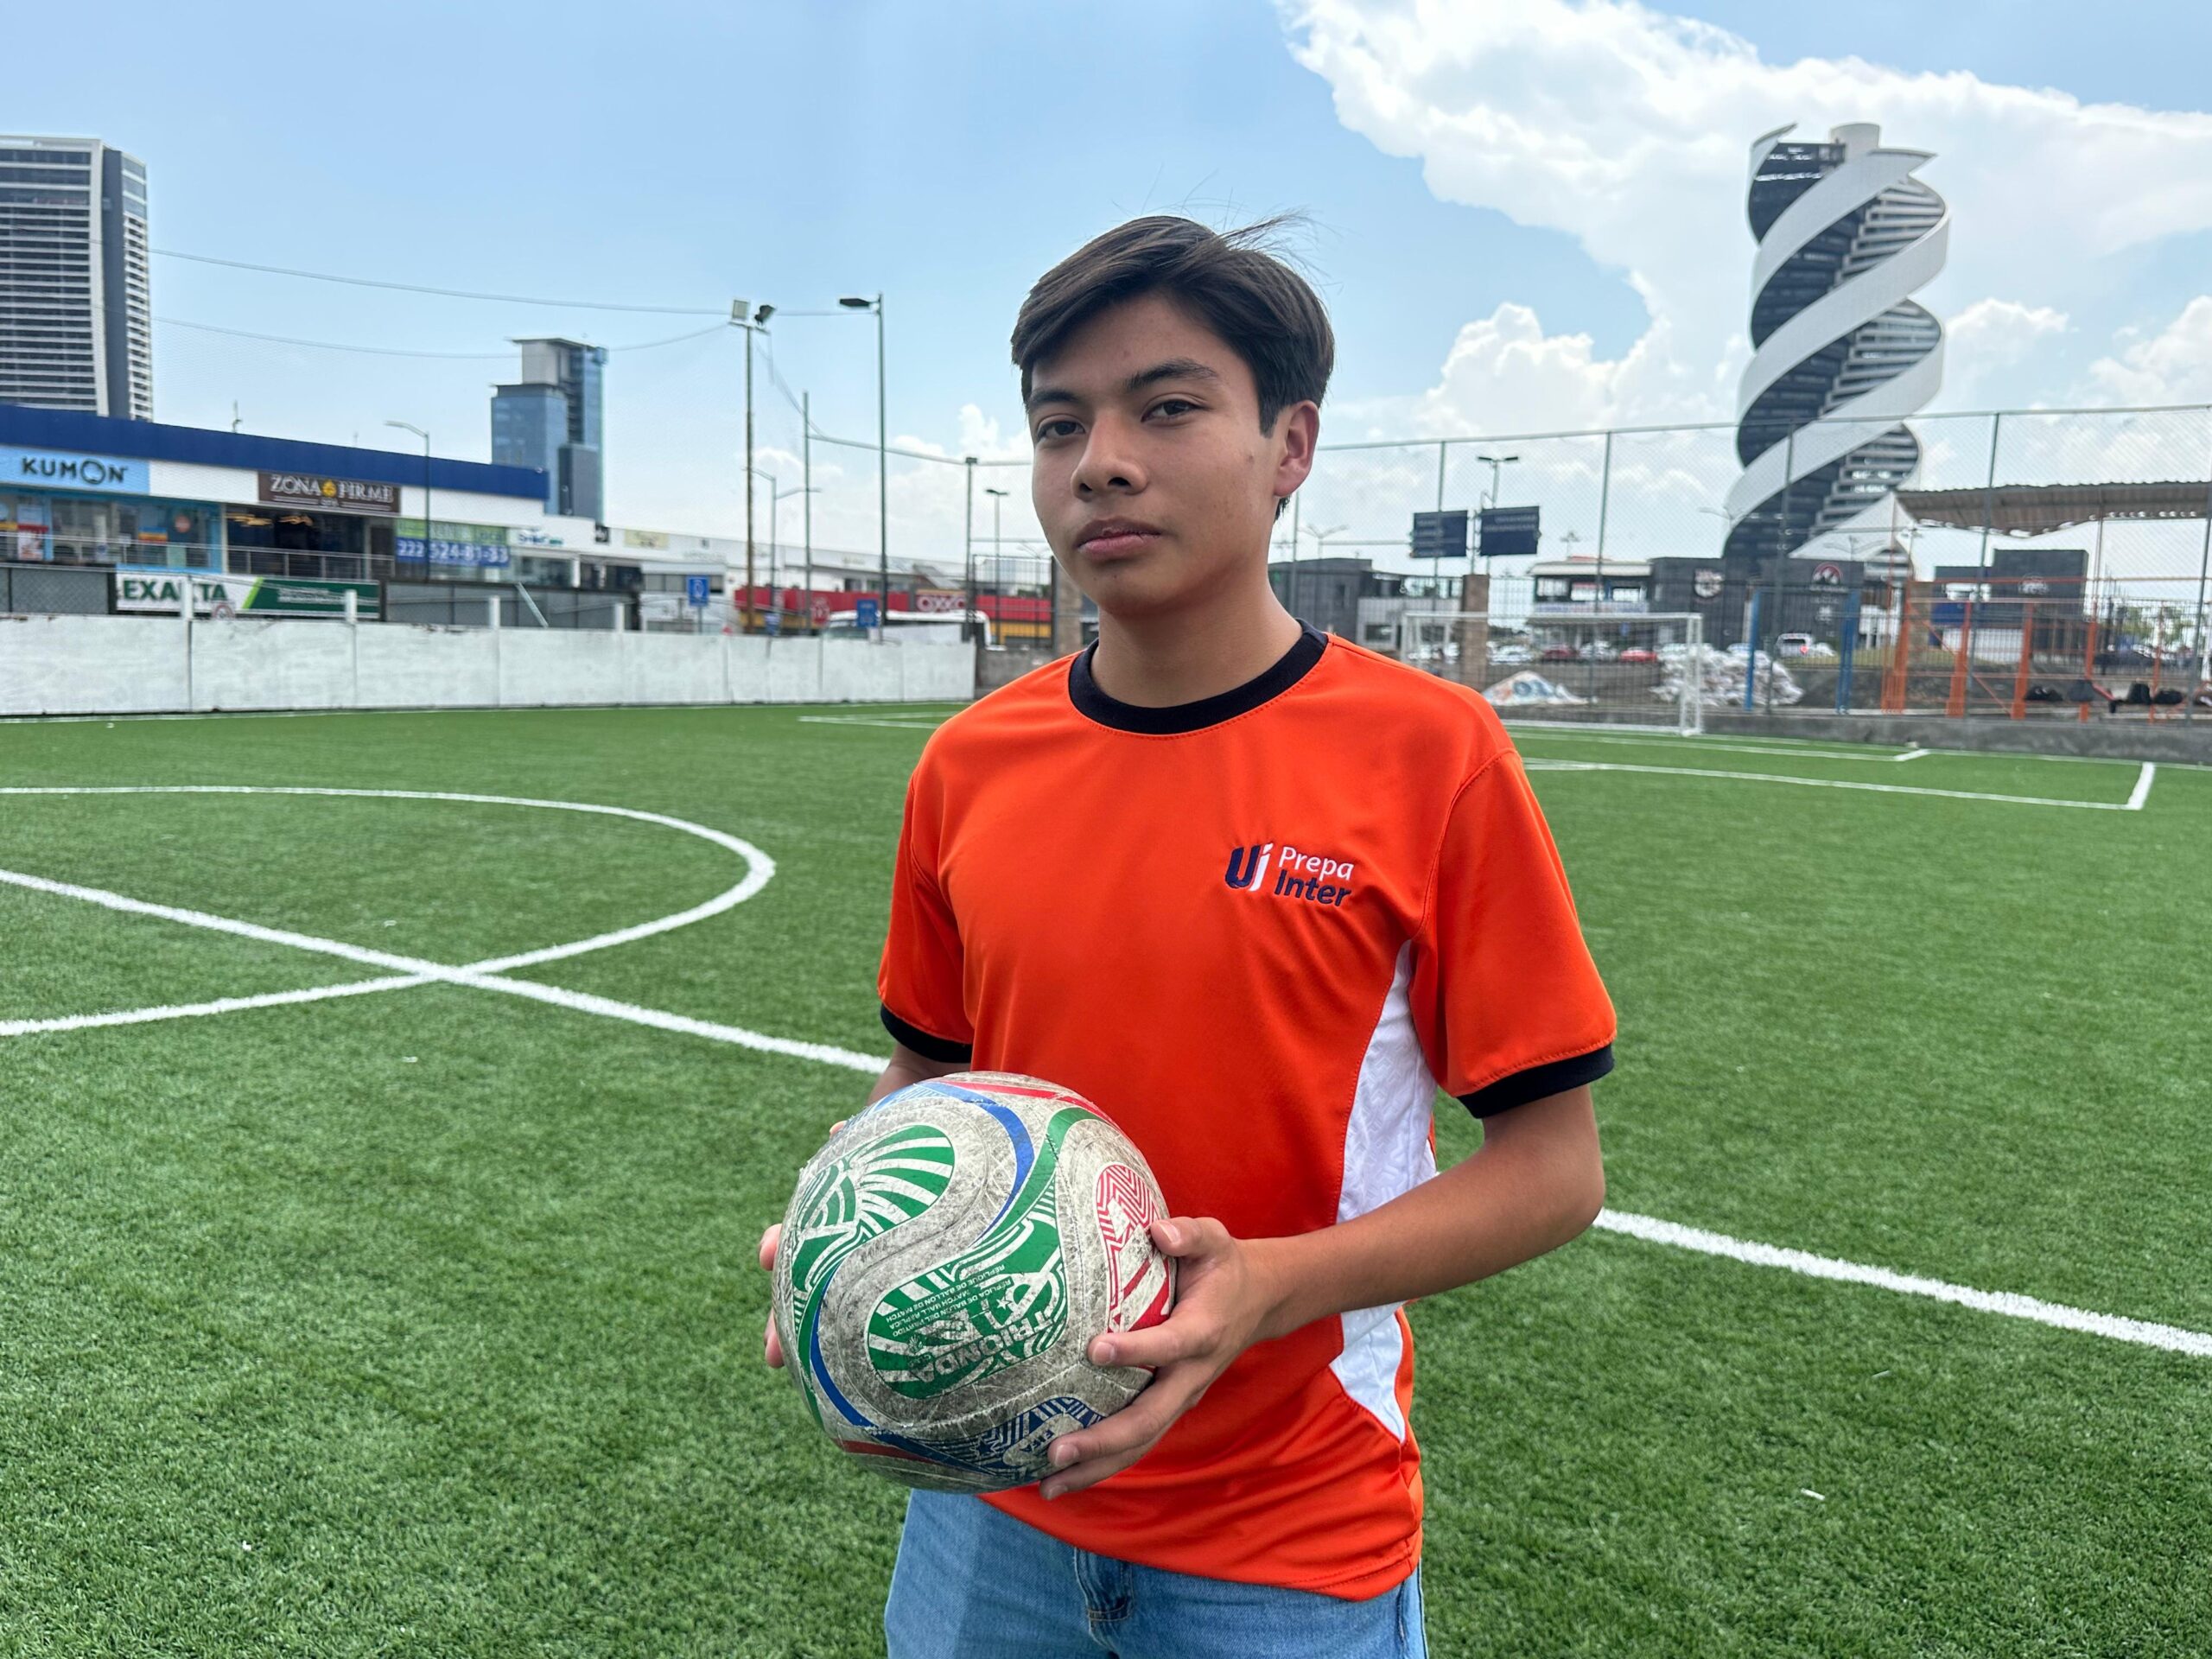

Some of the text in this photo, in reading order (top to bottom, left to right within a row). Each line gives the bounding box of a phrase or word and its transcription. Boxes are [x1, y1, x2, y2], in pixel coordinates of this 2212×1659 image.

[22, 455, 125, 486] KUMON
[270, 474, 321, 497] ZONA
[397, 537, 426, 558] 222
[123, 579, 228, 602] EXATA
[916, 595, 967, 613] OXXO
[1278, 845, 1355, 882] Prepa
[1274, 868, 1352, 907] Inter
[924, 1287, 956, 1306] BALLON
[941, 1289, 971, 1306] MATCH
[956, 1282, 967, 1292] DE
[966, 1295, 978, 1305] DE
[886, 1306, 913, 1323] MATCH
[911, 1311, 1053, 1382] TRIONDA
